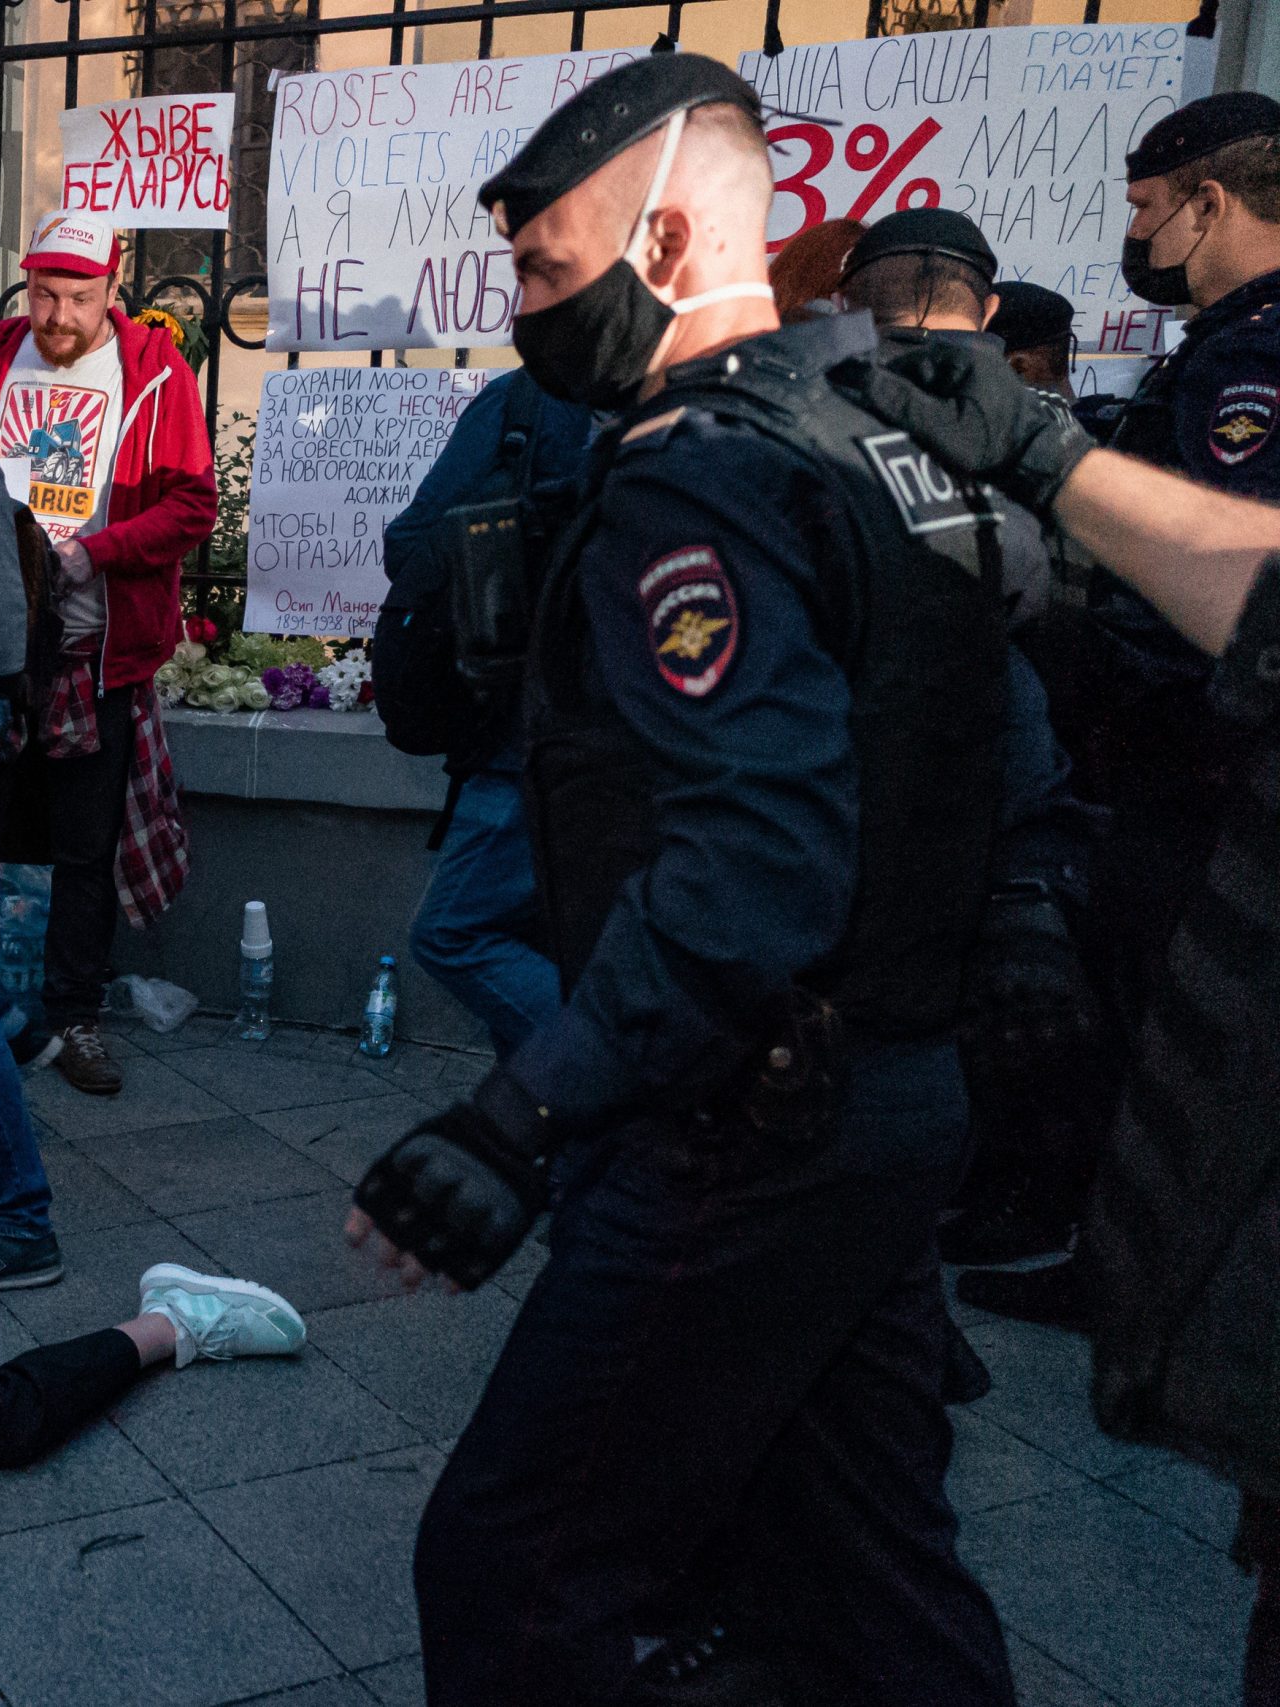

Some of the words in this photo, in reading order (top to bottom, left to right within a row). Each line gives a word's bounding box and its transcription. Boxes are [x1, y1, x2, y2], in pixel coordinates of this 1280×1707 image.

[1026, 26, 1180, 58] ГРОМКО
[739, 45, 844, 118] НАША
[864, 33, 992, 112] САША
[278, 71, 418, 140] ROSES
[449, 63, 524, 118] ARE
[99, 102, 218, 160] ЖЫВЕ
[278, 131, 452, 197] VIOLETS
[63, 154, 231, 212] БЕЛАРУСЬ
[59, 226, 95, 242] TOYOTA
[276, 204, 302, 264] А
[325, 189, 352, 257] Я
[295, 259, 370, 342] НЕ
[1098, 308, 1173, 352] НЕТ
[265, 367, 362, 398] СОХРАНИ
[368, 371, 428, 391] МОЮ
[265, 397, 288, 421] ЗА
[297, 393, 388, 417] ПРИВКУС
[263, 420, 285, 440] ЗА
[292, 415, 363, 440] СМОЛУ
[261, 440, 284, 461] ЗА
[291, 438, 401, 460] СОВЕСТНЫЙ
[259, 462, 273, 485] В
[281, 459, 415, 483] НОВГОРОДСКИХ
[28, 485, 89, 515] ARUS
[343, 483, 410, 505] ДОЛЖНА
[253, 511, 335, 539] ЧТОБЫ
[353, 511, 368, 538] В
[254, 538, 385, 572] ОТРАЗИЛ
[275, 589, 314, 613] Осип
[275, 613, 344, 632] 1891-1938
